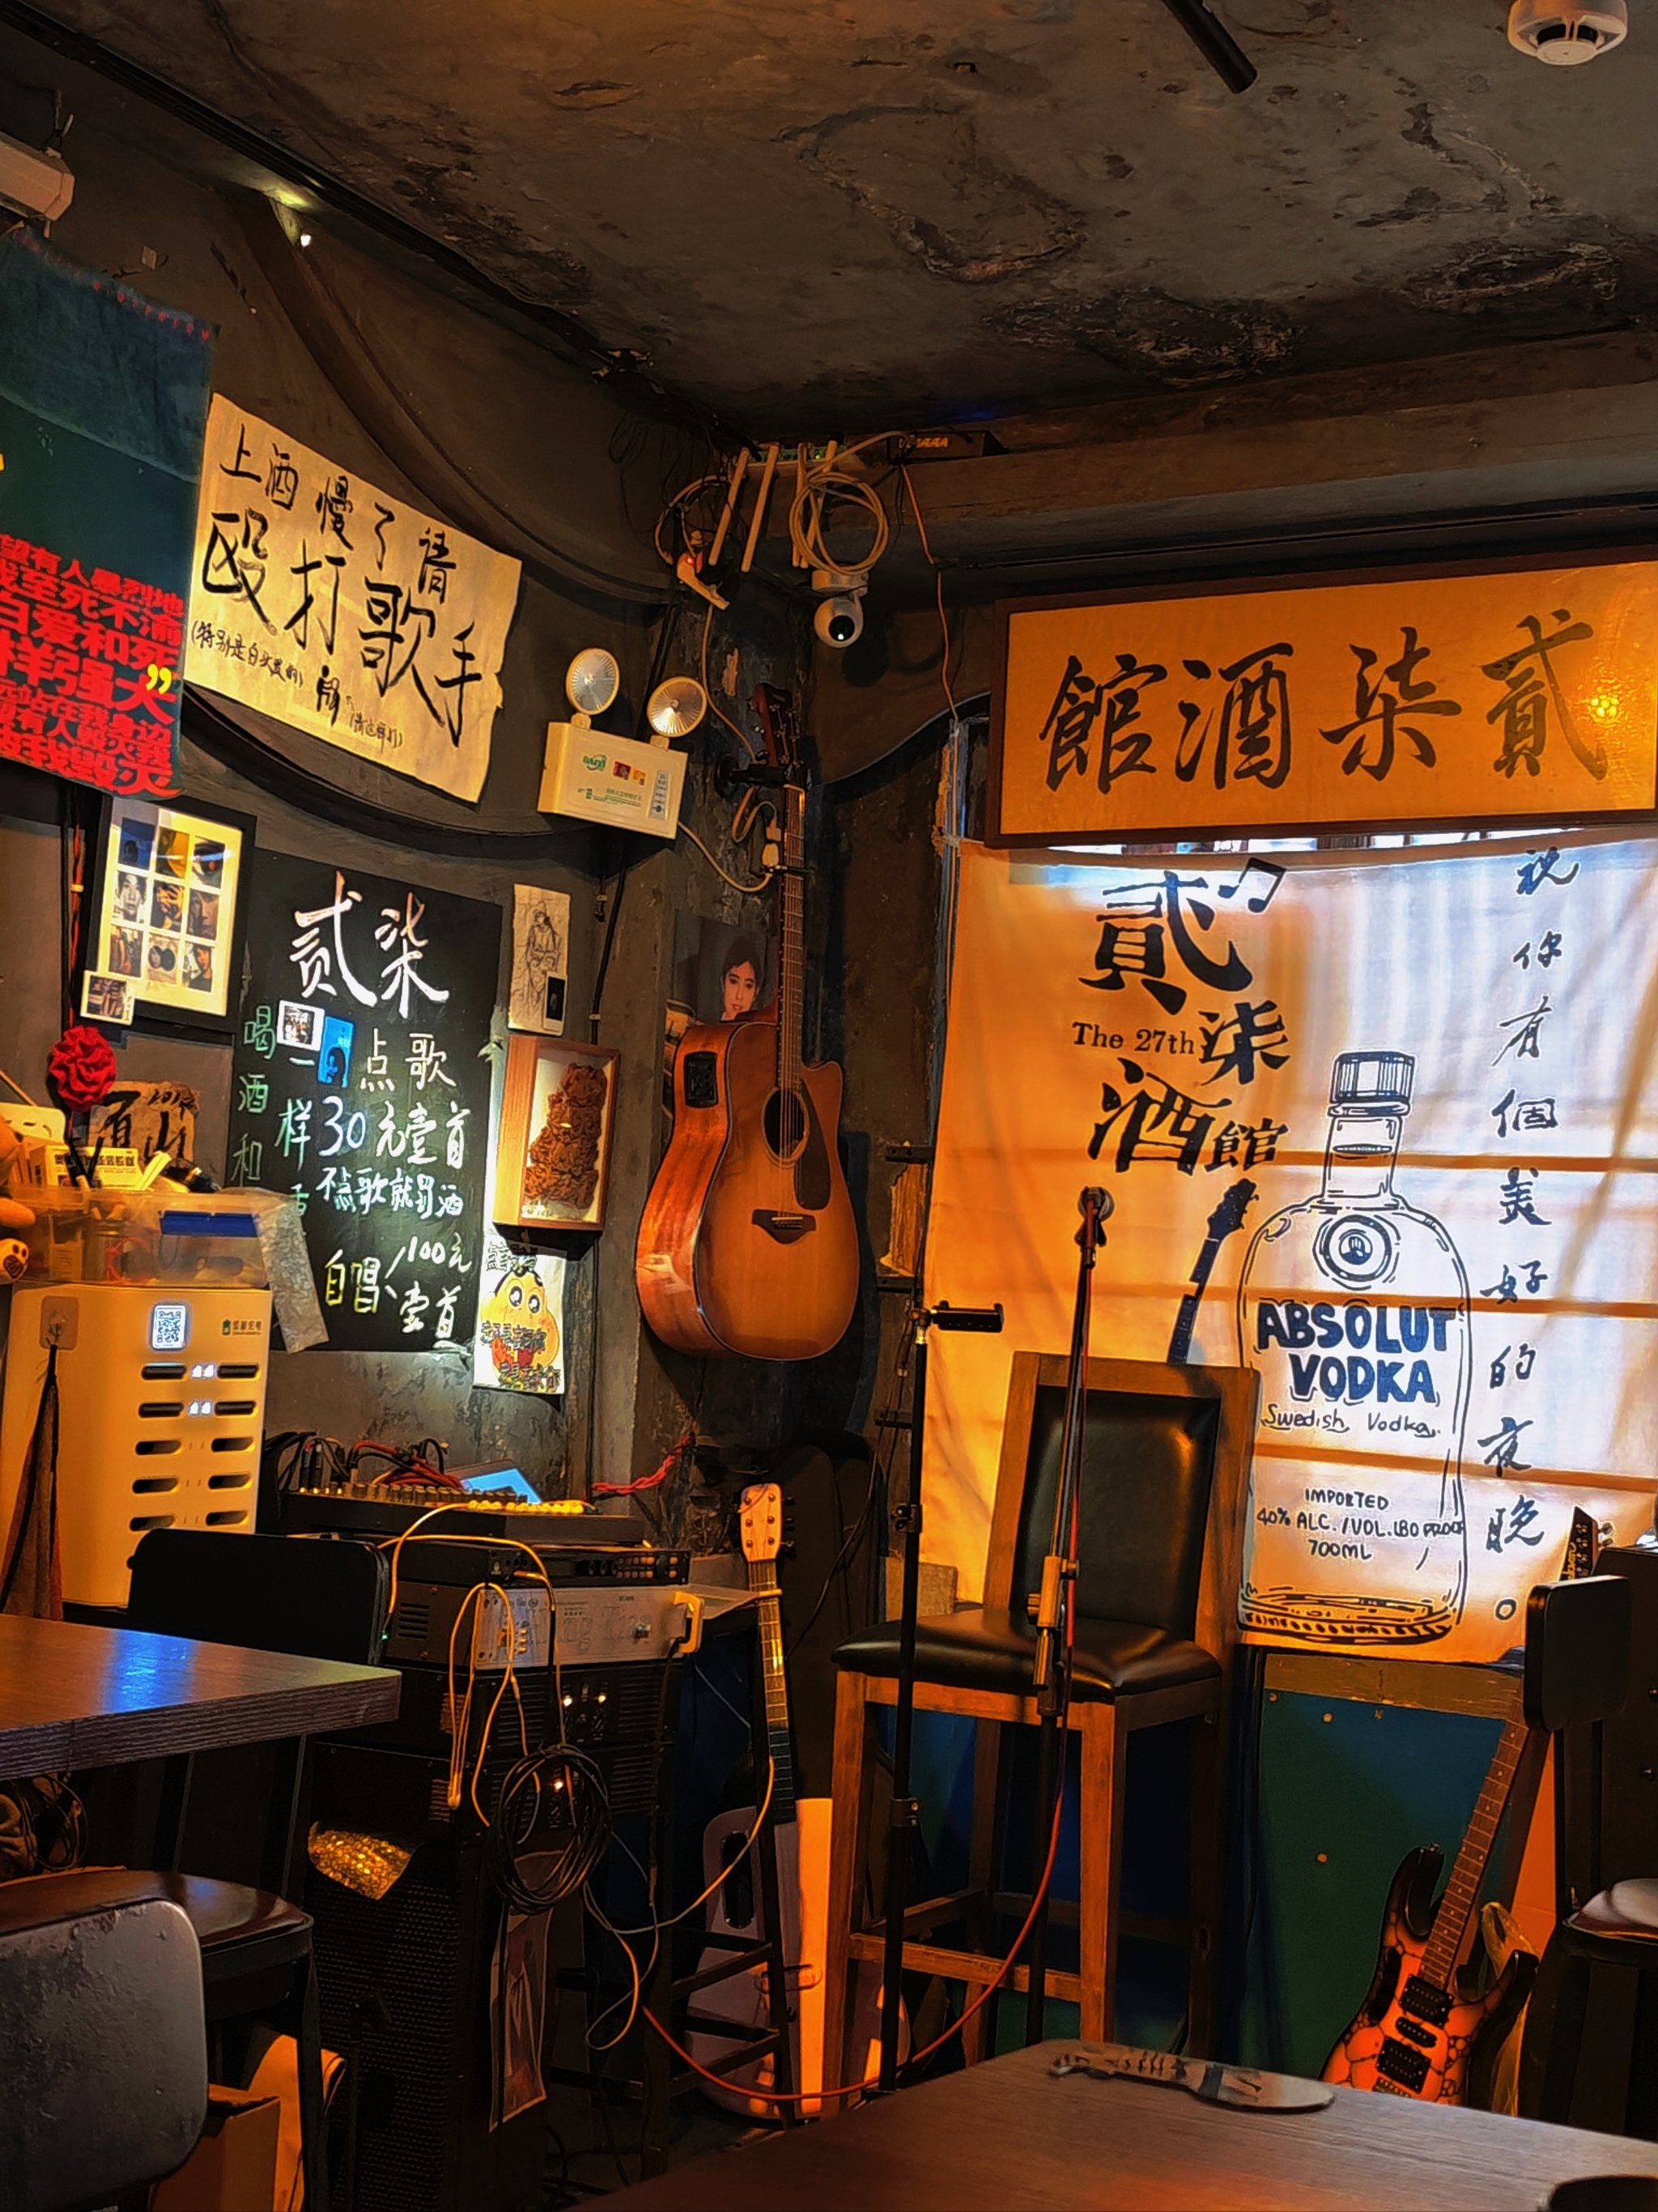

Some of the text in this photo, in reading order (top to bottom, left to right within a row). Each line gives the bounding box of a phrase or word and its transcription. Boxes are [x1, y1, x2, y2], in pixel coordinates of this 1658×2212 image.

[219, 423, 457, 605] 上酒慢了请
[202, 509, 483, 747] 殴打歌手
[1072, 1022, 1195, 1055] The 27th
[1256, 1301, 1457, 1352] ABSOLUT
[1290, 1353, 1437, 1404] VODKA
[1261, 1404, 1350, 1432] Swedish
[1304, 1487, 1390, 1511] IMPORTED
[1256, 1507, 1291, 1526] 40%
[1307, 1538, 1373, 1560] 700ML
